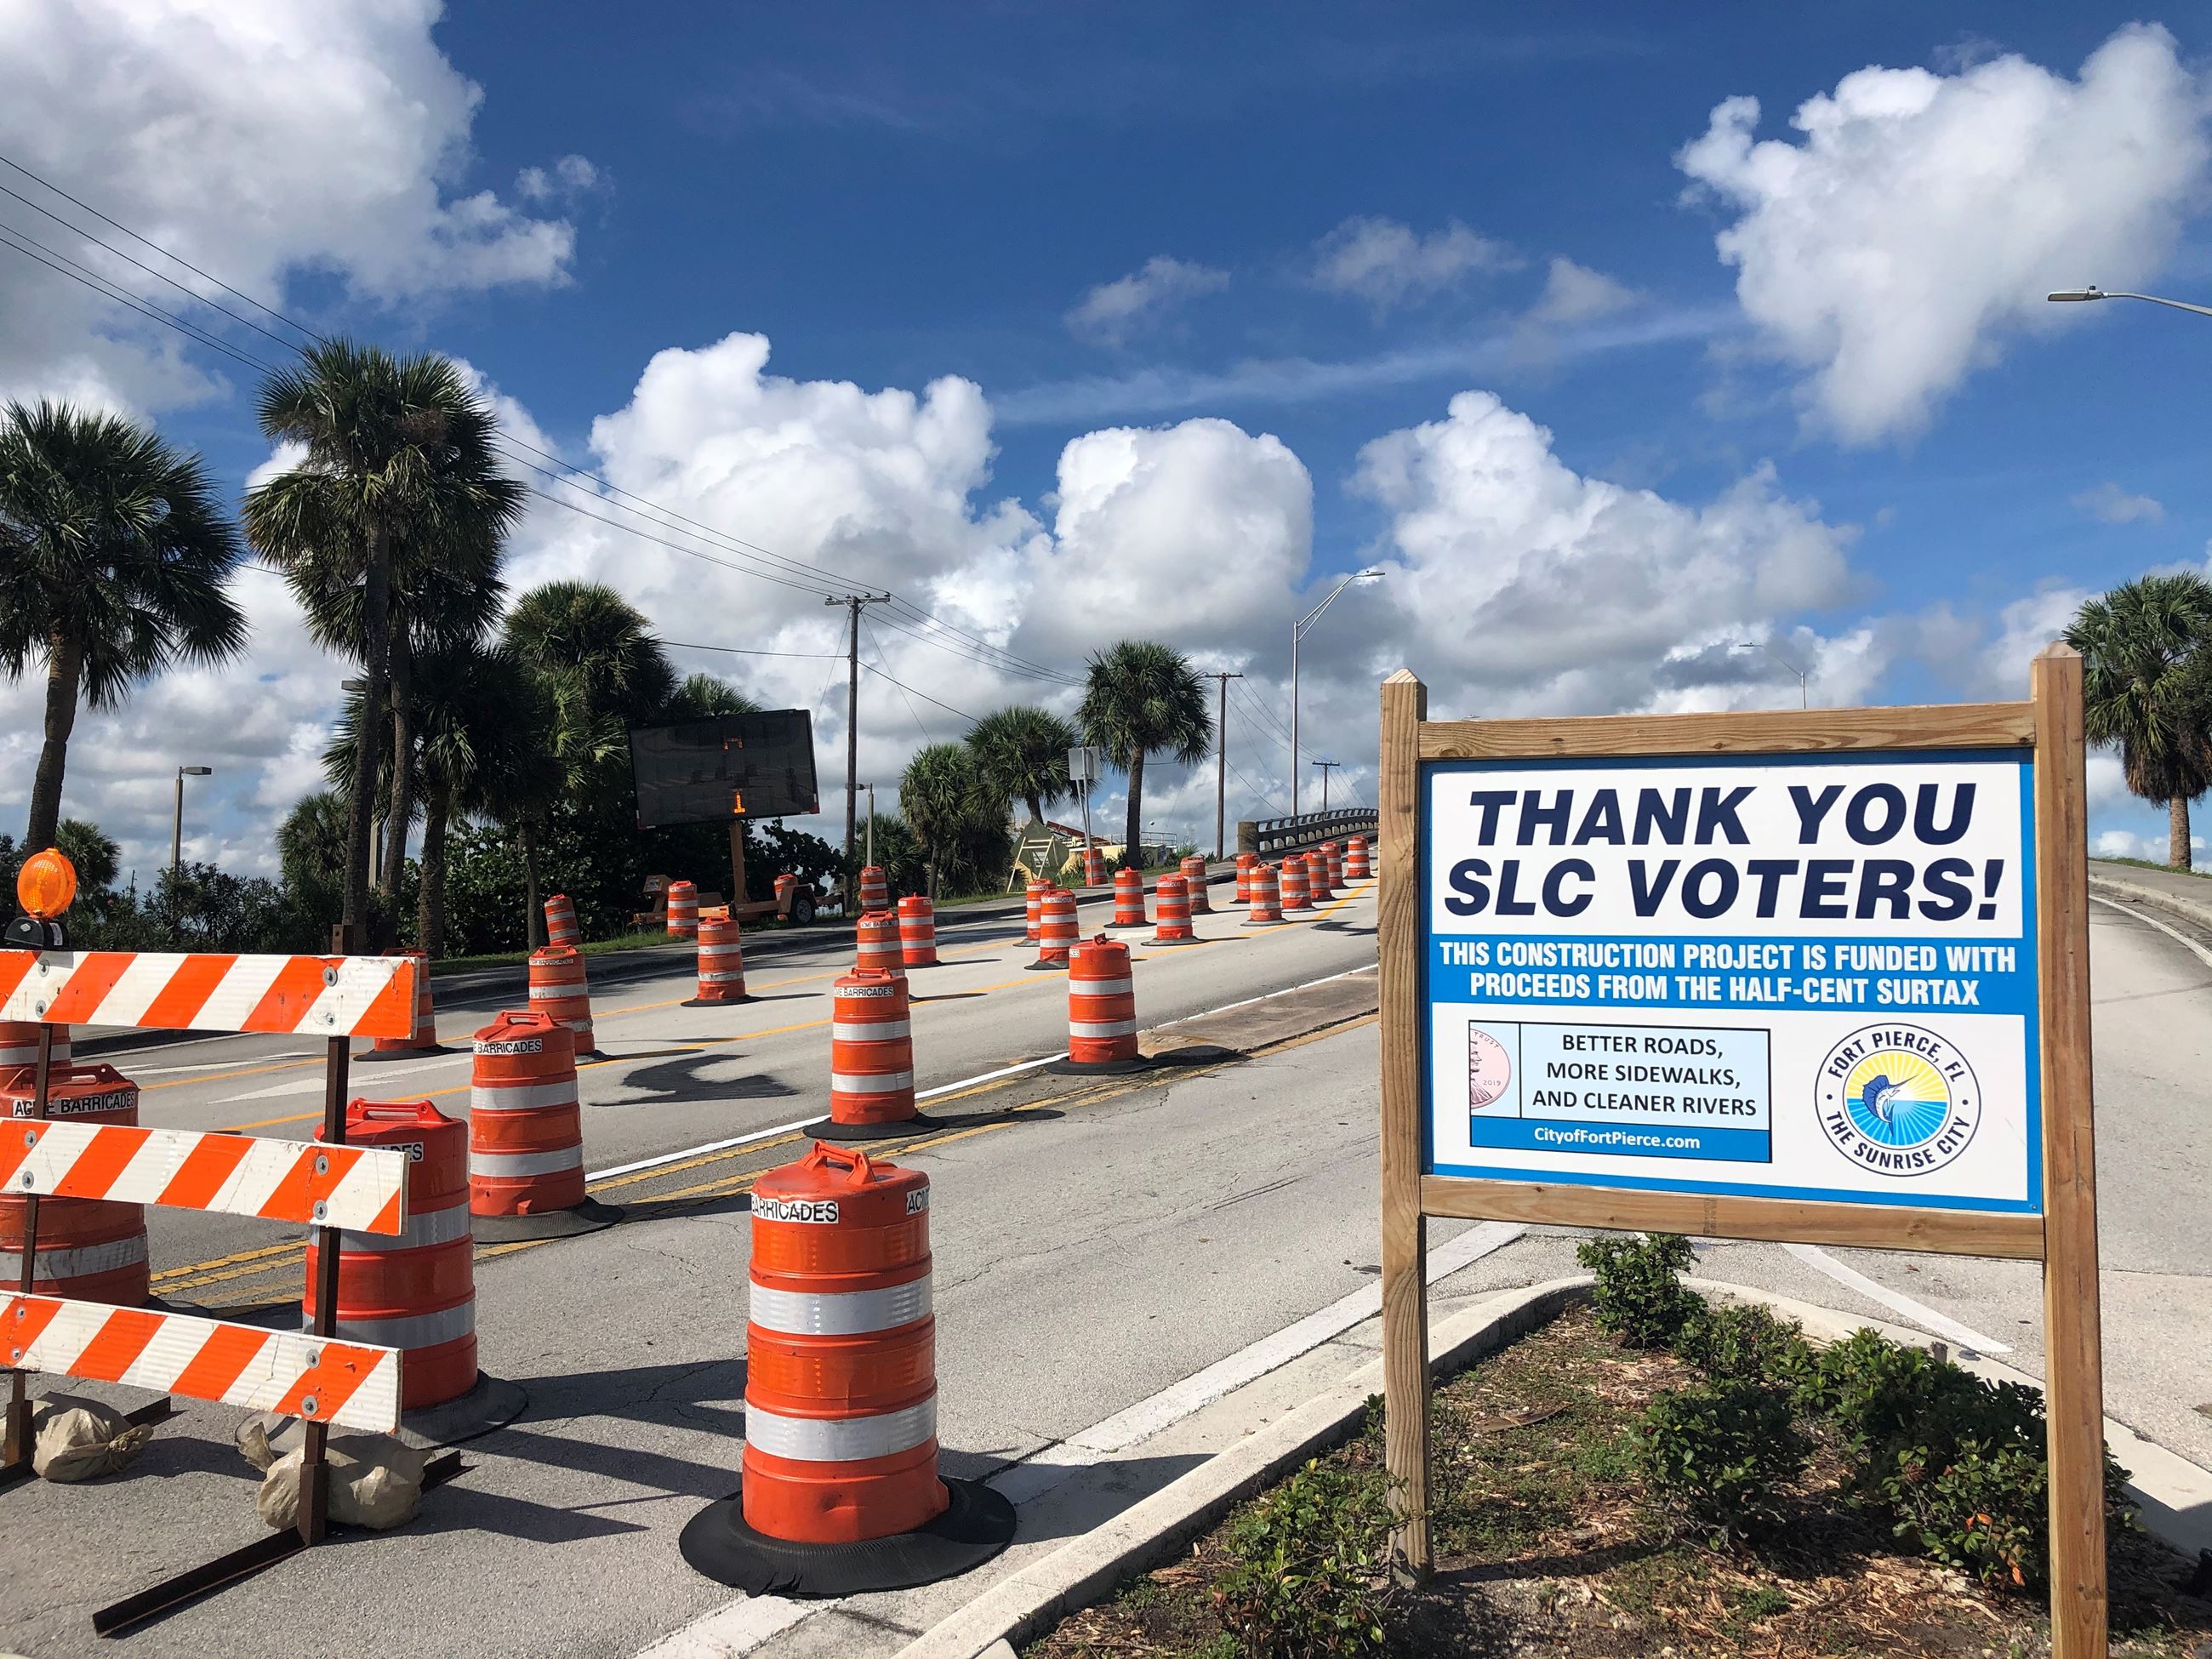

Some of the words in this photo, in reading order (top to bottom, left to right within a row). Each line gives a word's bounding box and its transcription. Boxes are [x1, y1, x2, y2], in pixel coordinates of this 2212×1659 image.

[1468, 786, 1758, 847] THANK
[1787, 783, 1976, 847] YOU
[1445, 858, 1596, 917] SLC
[1628, 858, 2005, 922] VOTERS!
[1440, 942, 1490, 966] THIS
[1497, 943, 1675, 968] CONSTRUCTION
[1684, 944, 1794, 971] PROJECT
[1803, 945, 1827, 971] IS
[1835, 945, 1937, 972] FUNDED
[1945, 946, 2015, 972] WITH
[844, 987, 893, 996] BARRICADES
[1470, 972, 1590, 999] PROCEEDS
[1598, 974, 1668, 1000] FROM
[1675, 975, 1722, 1001] THE
[1730, 977, 1868, 1003] HALF-CENT
[1876, 979, 1980, 1006] SURTAX
[478, 1040, 542, 1054] BARRICADES
[1474, 1031, 1499, 1048] TRUST
[1563, 1035, 1637, 1053] BETTER
[1645, 1037, 1723, 1059] ROADS,
[1827, 1039, 1866, 1079] FORT
[1872, 1031, 1941, 1063] PIERCE,
[1944, 1061, 1965, 1082] FL
[1547, 1062, 1609, 1080] MORE
[1615, 1064, 1741, 1089] SIDEWALKS,
[14, 1100, 55, 1116] ACE
[60, 1092, 134, 1114] BARRICADES
[1532, 1090, 1577, 1108] AND
[1584, 1092, 1675, 1113] CLEANER
[1683, 1097, 1757, 1116] RIVERS
[1534, 1127, 1701, 1149] CityofFortPierce.com
[1827, 1111, 1855, 1144] THE
[1854, 1143, 1936, 1169] SUNRISE
[1936, 1115, 1970, 1154] CITY
[752, 1194, 838, 1222] BARRICADES
